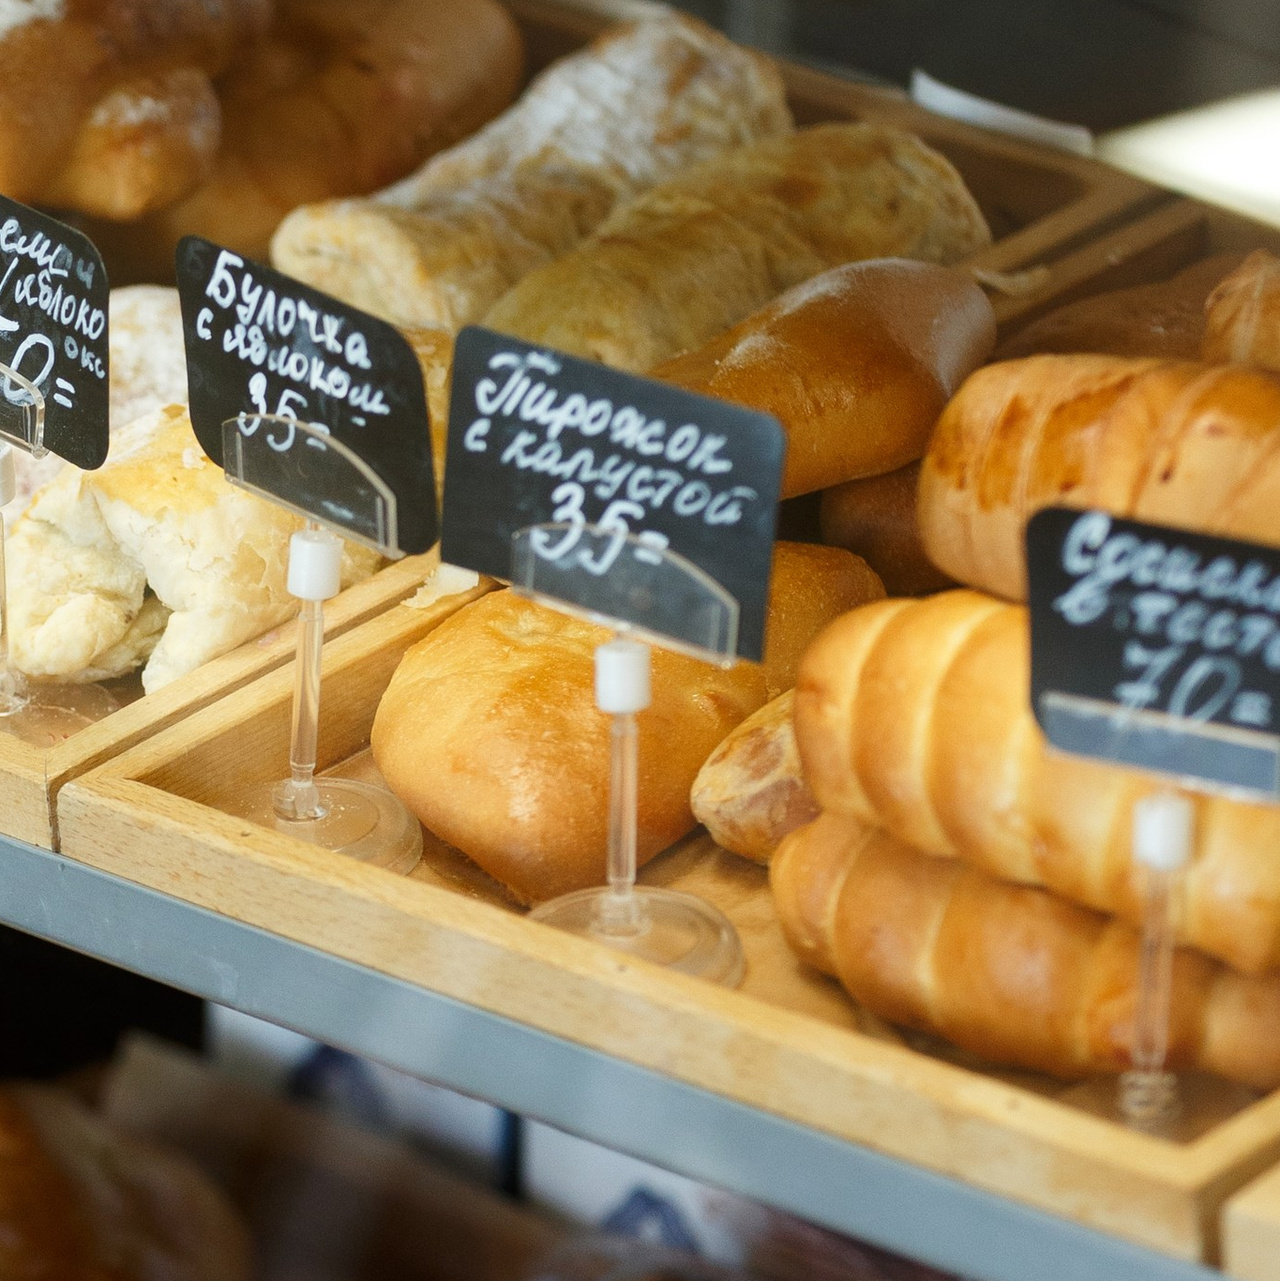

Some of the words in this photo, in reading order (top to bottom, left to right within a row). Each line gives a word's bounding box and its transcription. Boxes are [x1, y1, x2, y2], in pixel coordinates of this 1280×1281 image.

[196, 306, 215, 341] с
[205, 248, 373, 370] Булочка
[464, 417, 492, 452] с
[475, 349, 733, 476] Пирожок
